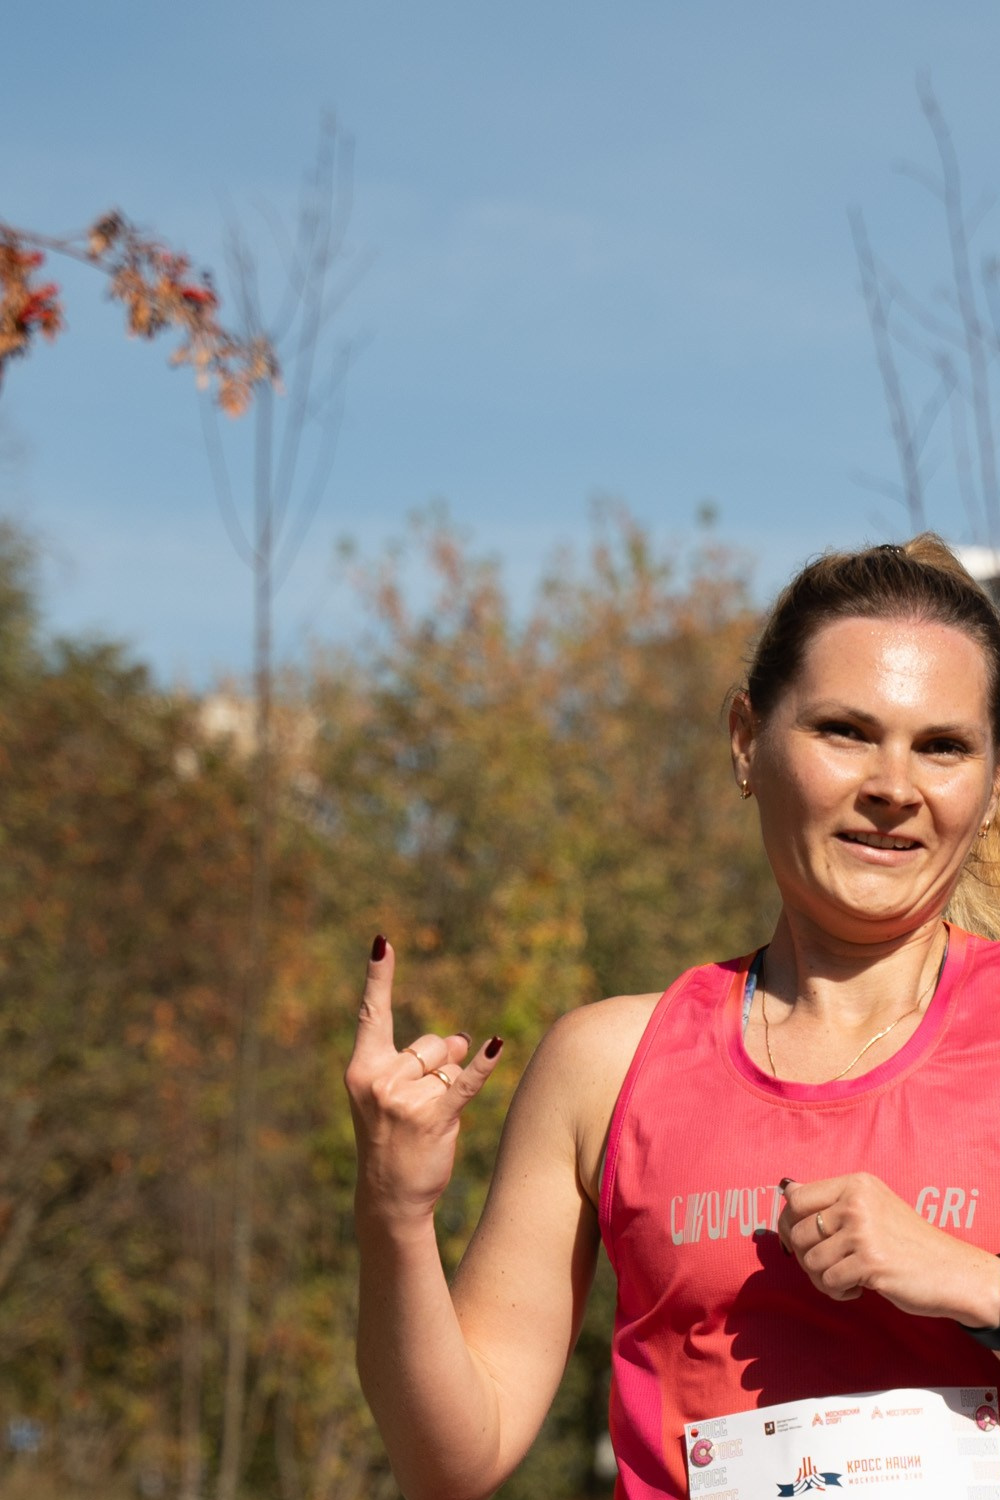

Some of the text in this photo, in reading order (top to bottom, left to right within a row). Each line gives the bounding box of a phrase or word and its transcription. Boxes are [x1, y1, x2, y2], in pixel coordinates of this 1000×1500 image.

[670, 1186, 783, 1246] СКОРОСТ
[846, 1455, 921, 1474] КРОСС НАЦИИ
